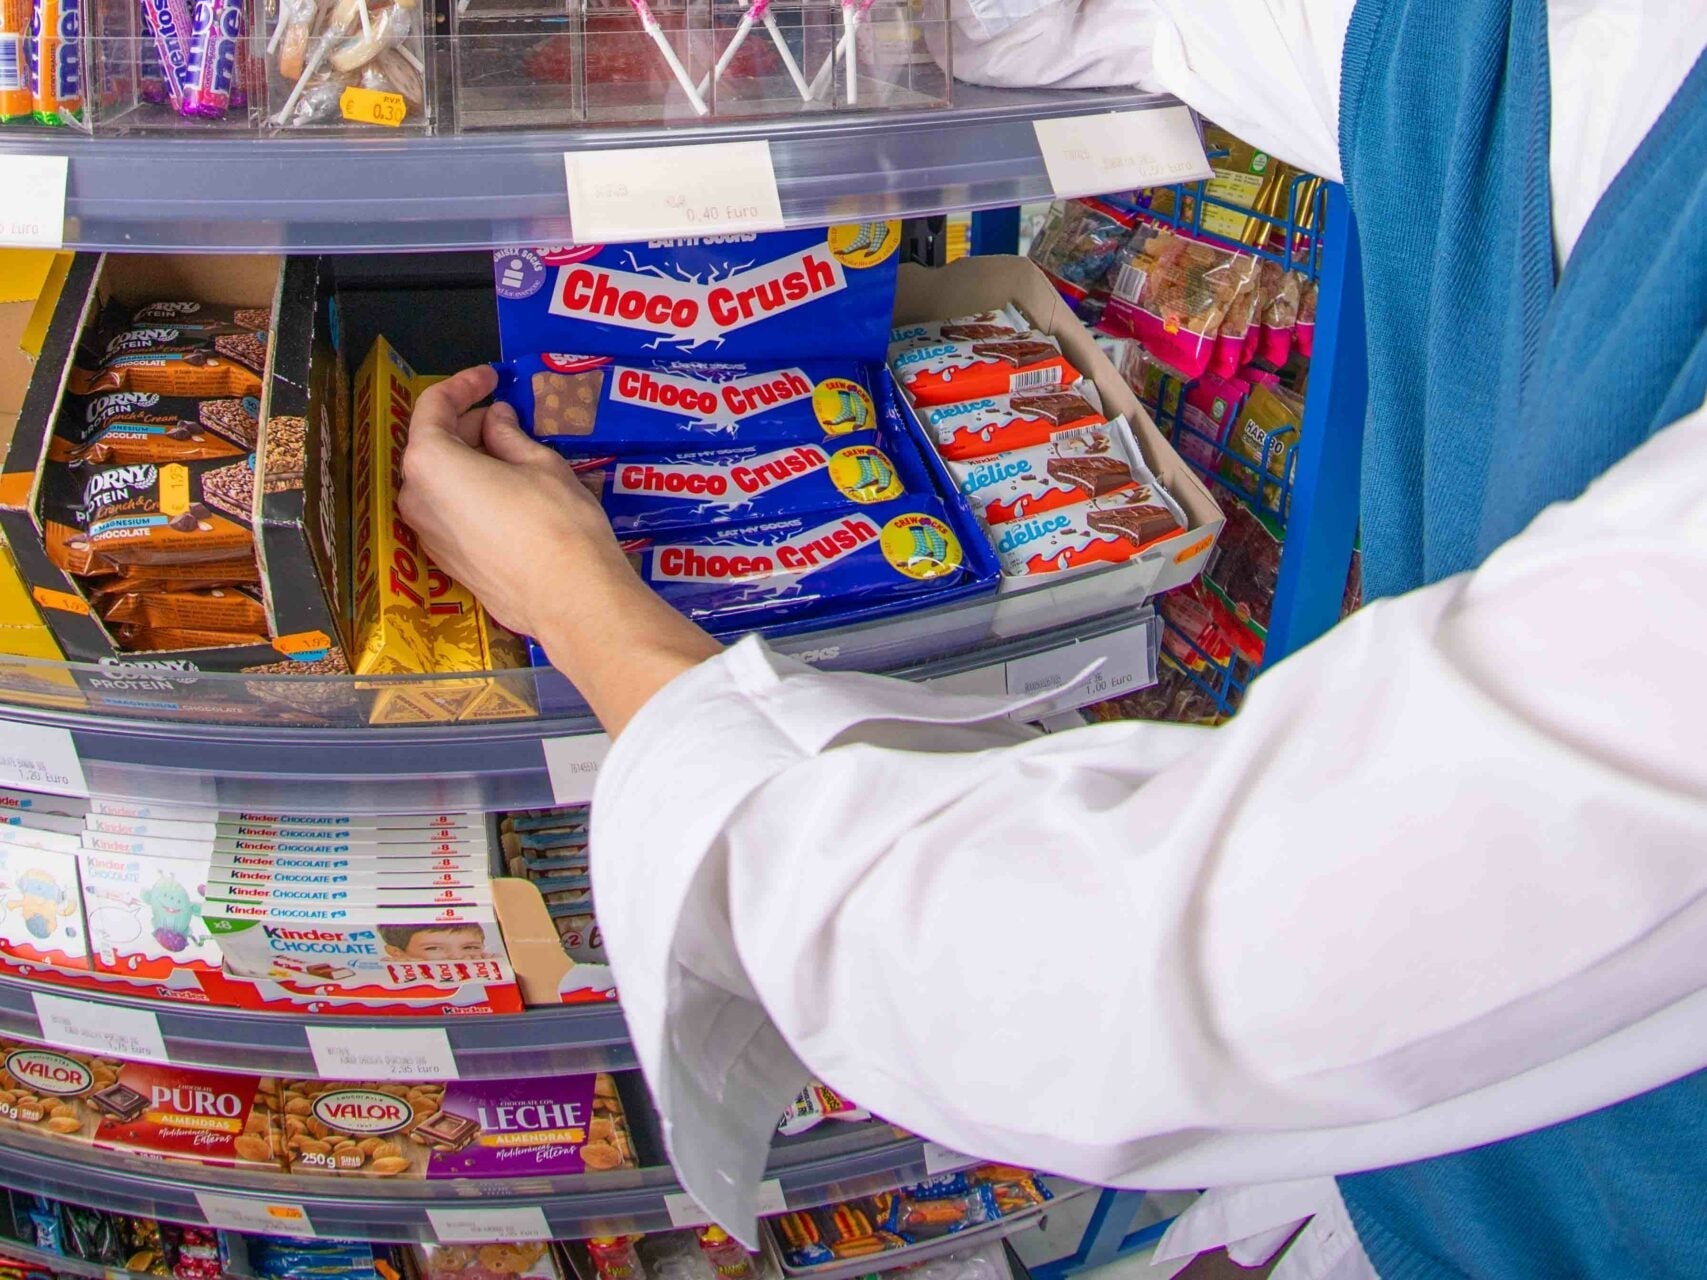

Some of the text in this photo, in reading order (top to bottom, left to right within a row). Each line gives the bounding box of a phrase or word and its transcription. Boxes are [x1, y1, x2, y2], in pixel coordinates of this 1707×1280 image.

[727, 205, 758, 219] Euro
[521, 250, 543, 272] SOCKS
[562, 254, 836, 329] Choco Crush
[106, 329, 178, 352] CORNY
[115, 360, 166, 368] CHOCOLATE
[618, 370, 812, 415] Choco Crush
[86, 392, 159, 423] CORNY
[144, 414, 178, 423] Cream
[1244, 418, 1285, 459] HARBO
[715, 446, 757, 456] SOCKS
[621, 446, 826, 496] Choco Crush
[960, 458, 1032, 496] délice
[717, 519, 802, 538] EAT MY SOCKS
[894, 516, 919, 528] CREW
[94, 528, 150, 541] CHOCOLATE
[999, 513, 1072, 554] délice
[660, 520, 878, 578] Choco Crush
[90, 678, 175, 691] PROTEIN
[1111, 674, 1133, 689] Euro
[45, 775, 69, 785] Euro
[240, 813, 333, 825] Kinder CHOCOLATE
[238, 827, 332, 839] Kinder CHOCOLATE
[236, 841, 332, 853] Kinder CHOCOLATE
[233, 856, 331, 868] Kinder CHOCOLATE
[231, 870, 330, 884] Kinder CHOCOLATE
[228, 886, 329, 900] Kinder CHOCOLATE
[225, 904, 328, 919] Kinder CHOCOLATE
[263, 924, 343, 942] Kinder
[270, 938, 378, 956] CHOCOLATE
[442, 1005, 493, 1015] Kinder
[16, 1058, 82, 1086] VALOR
[151, 1085, 242, 1117] PURO
[500, 1099, 538, 1107] CHOCOLATE
[324, 1103, 401, 1121] VALOR
[477, 1103, 586, 1132] LECHE
[161, 1115, 231, 1130] ALMENDRAS
[495, 1132, 572, 1145] ALMENDRAS
[301, 1152, 336, 1169] 250 g
